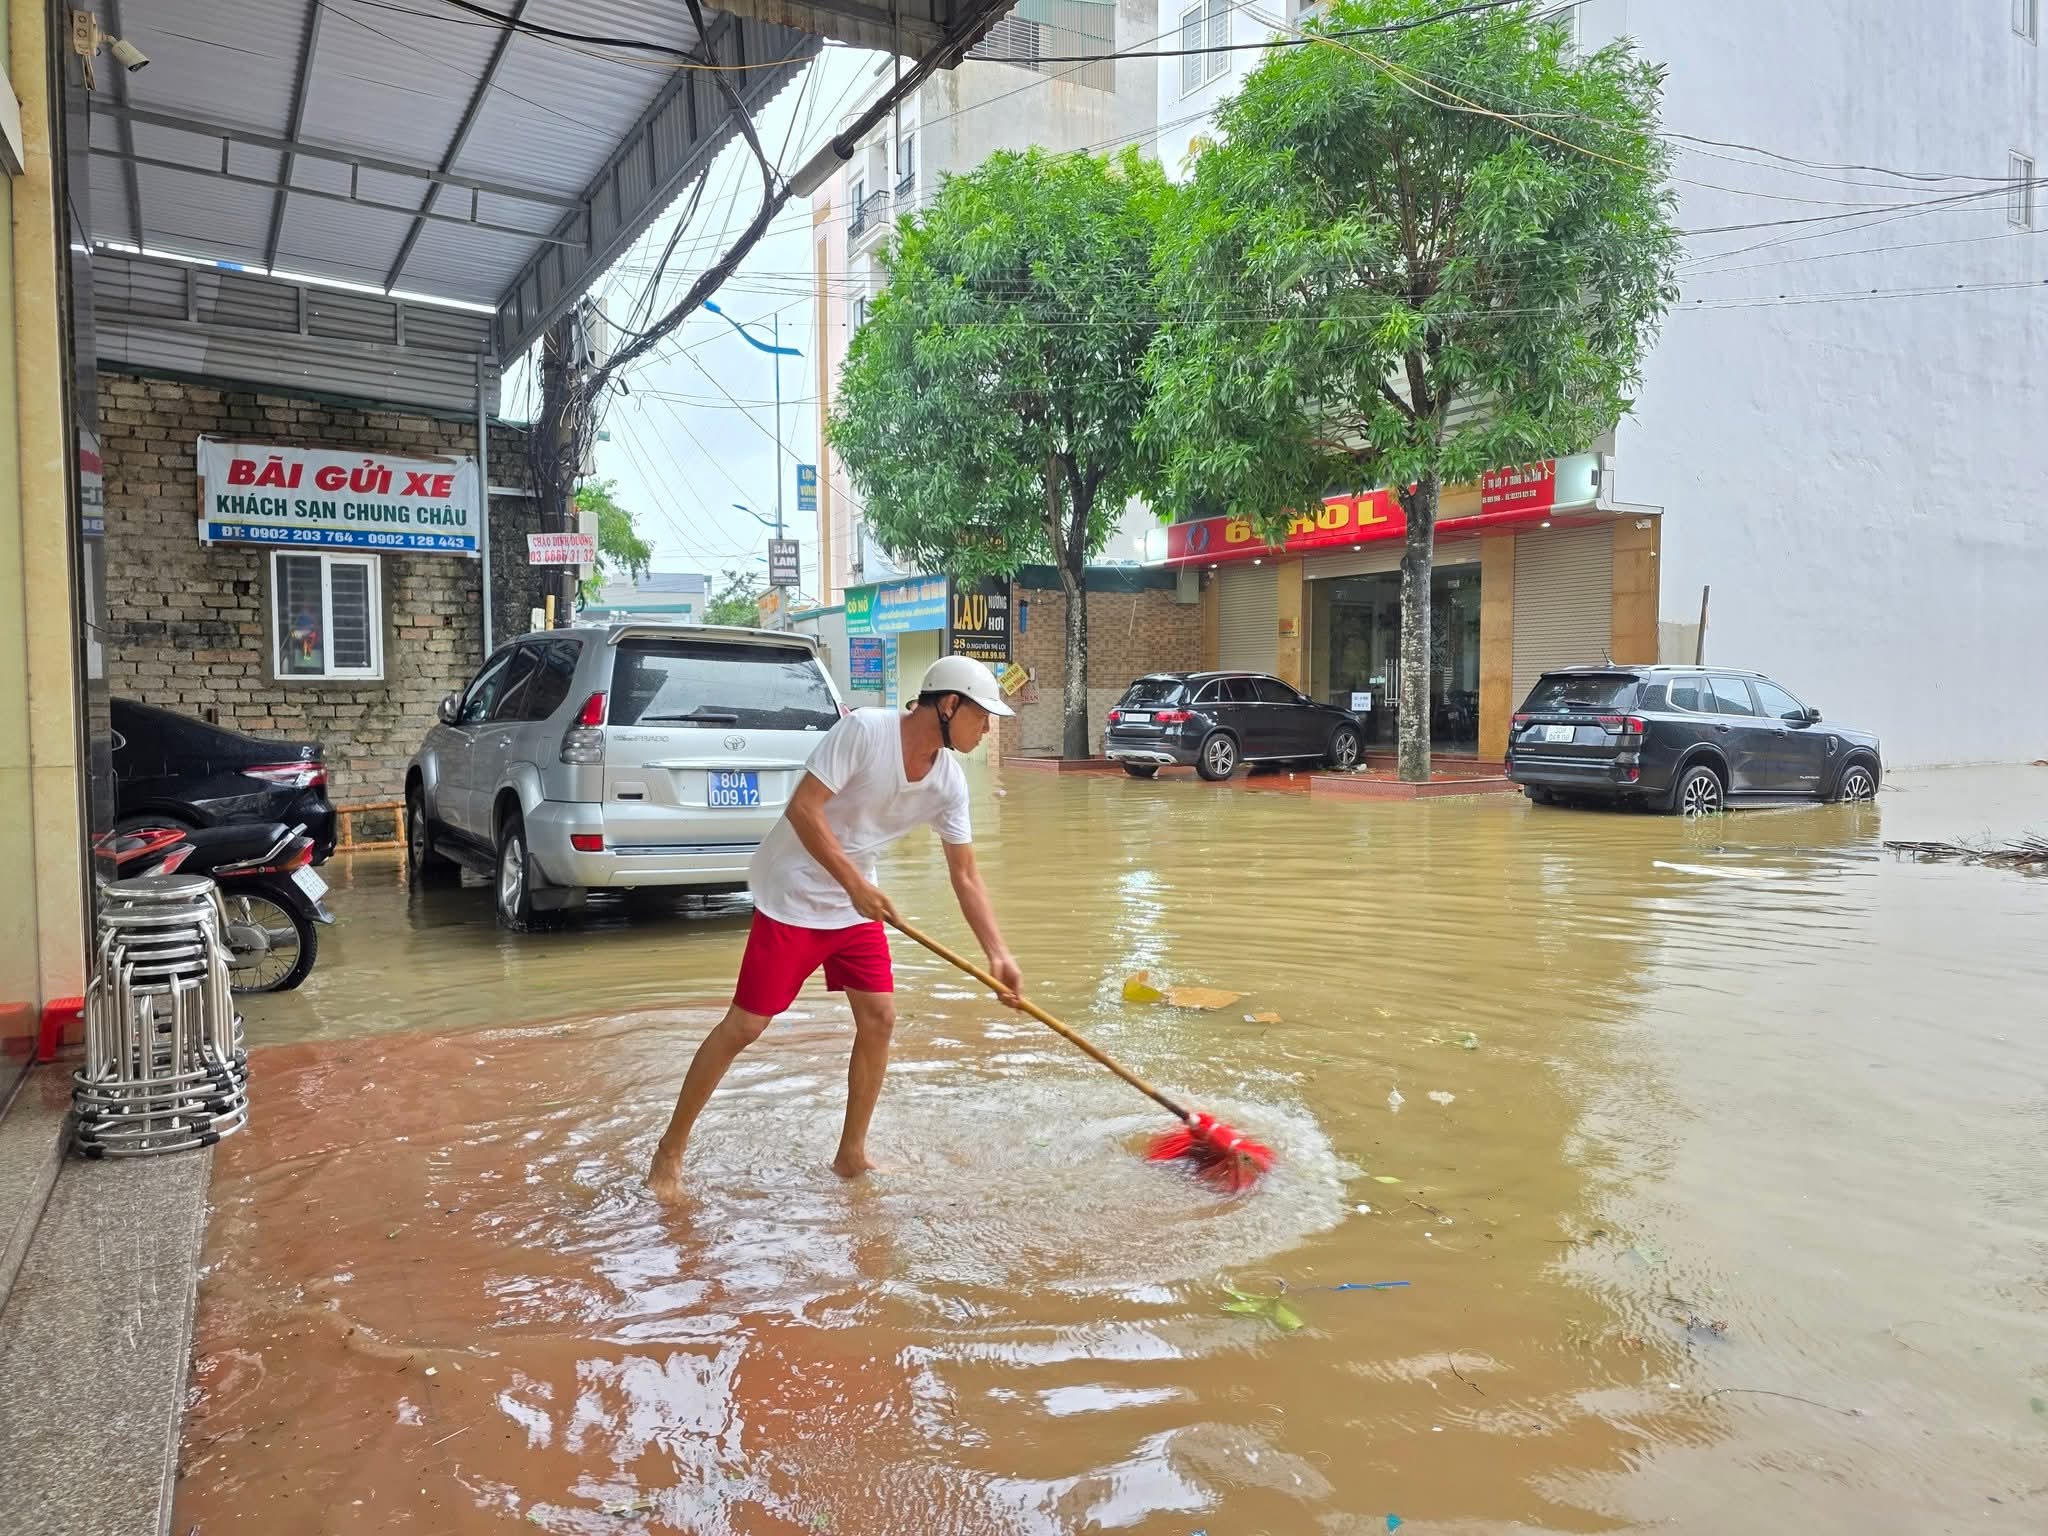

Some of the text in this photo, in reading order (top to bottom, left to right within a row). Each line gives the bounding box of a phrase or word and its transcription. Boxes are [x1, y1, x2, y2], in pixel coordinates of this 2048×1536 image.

[227, 455, 456, 498] BÃI GỬI XE
[216, 492, 467, 526] KHÁCH SẠN CHUNG CHÂU
[221, 525, 246, 538] ĐT:
[250, 527, 289, 541] 0902
[293, 529, 321, 542] 203
[325, 531, 354, 543] 764
[367, 533, 404, 546] 0902
[408, 535, 435, 547] 128
[438, 537, 465, 548] 443
[530, 551, 542, 563] 03
[583, 548, 595, 562] 32
[988, 615, 1005, 631] HƠI
[953, 638, 967, 649] 28
[720, 772, 748, 788] 80A
[711, 788, 760, 806] 009.12
